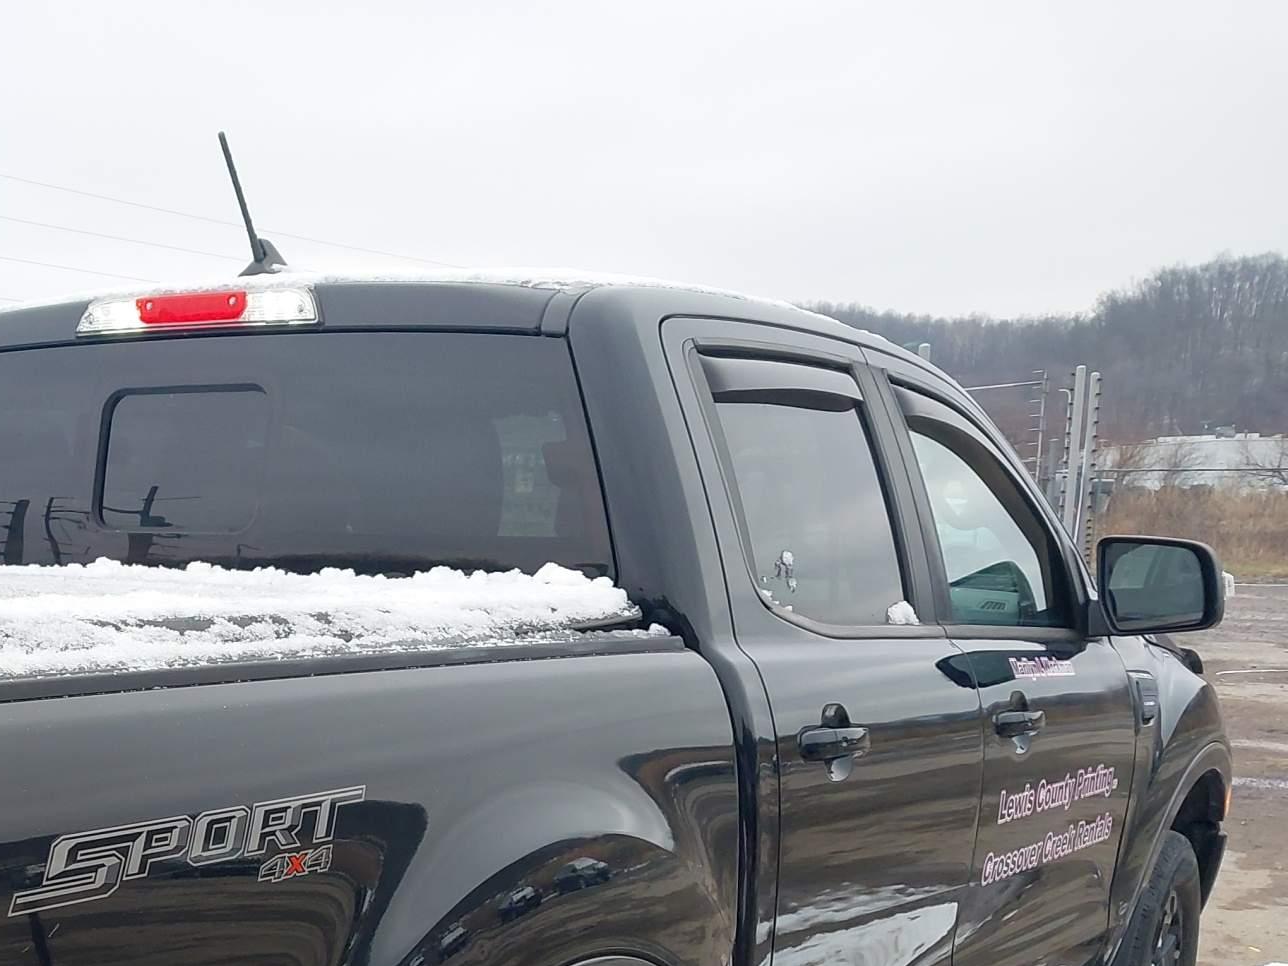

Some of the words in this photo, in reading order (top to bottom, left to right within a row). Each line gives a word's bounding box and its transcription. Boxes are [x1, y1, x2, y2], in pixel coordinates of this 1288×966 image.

[998, 784, 1035, 825] Lewis
[1036, 773, 1076, 810] County
[7, 784, 367, 917] SPORT
[981, 839, 1043, 887] Crossover
[1042, 825, 1076, 863] Creek
[1075, 812, 1113, 852] Rentals
